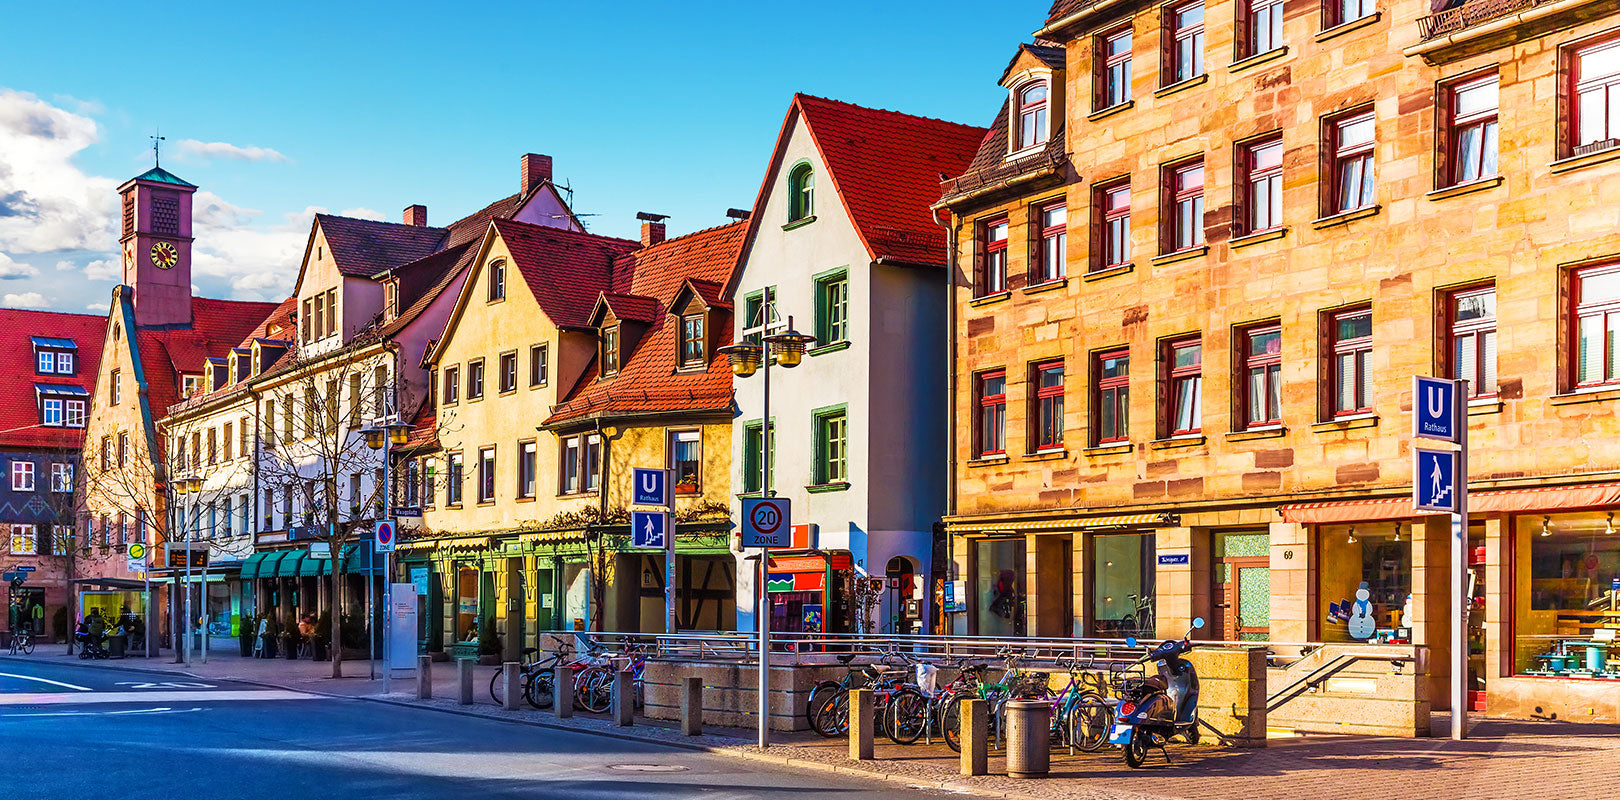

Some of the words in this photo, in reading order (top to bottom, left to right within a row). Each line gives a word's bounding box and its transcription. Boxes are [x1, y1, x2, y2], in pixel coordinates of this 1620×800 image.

[1428, 386, 1443, 418] U
[1424, 421, 1447, 433] Rathaus
[643, 473, 656, 493] U
[640, 494, 659, 502] Rathaus
[758, 510, 776, 525] 20
[754, 535, 779, 544] ZONE
[1284, 550, 1293, 560] 69
